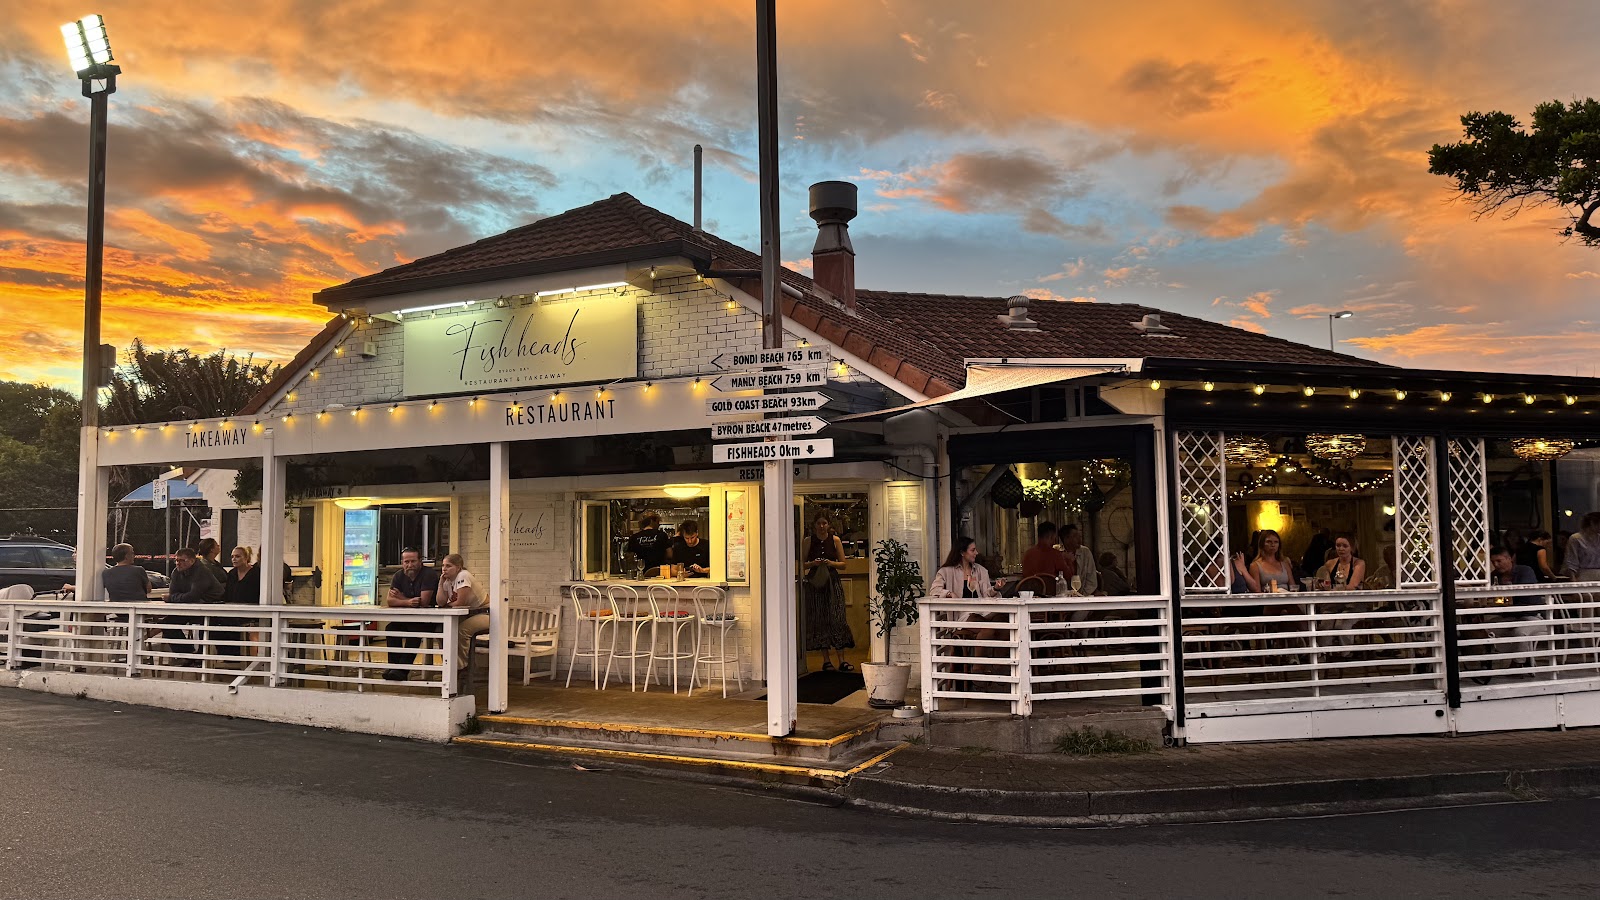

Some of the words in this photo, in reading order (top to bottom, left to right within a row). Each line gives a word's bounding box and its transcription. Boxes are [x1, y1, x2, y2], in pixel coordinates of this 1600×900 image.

[445, 315, 514, 381] Fish
[517, 308, 587, 366] heads
[733, 354, 758, 365] BONDI
[760, 352, 784, 363] BEACH
[787, 350, 803, 361] 765
[808, 350, 822, 360] km
[464, 377, 513, 386] RESTAURANT
[524, 373, 566, 381] TAKEAWAY
[731, 377, 756, 388] MANLY
[758, 374, 782, 386] BEACH
[785, 373, 801, 383] 759
[806, 372, 820, 382] km
[712, 400, 732, 411] GOLD
[735, 399, 759, 410] COAST
[762, 398, 788, 409] BEACH
[790, 396, 816, 407] 93km
[506, 400, 615, 426] RESTAURANT
[717, 424, 743, 435] BYRON
[746, 422, 771, 433] BEACH
[772, 421, 812, 431] 47metres
[185, 428, 247, 449] TAKEAWAY
[727, 445, 776, 460] FISHHEADS
[779, 444, 800, 457] 0km
